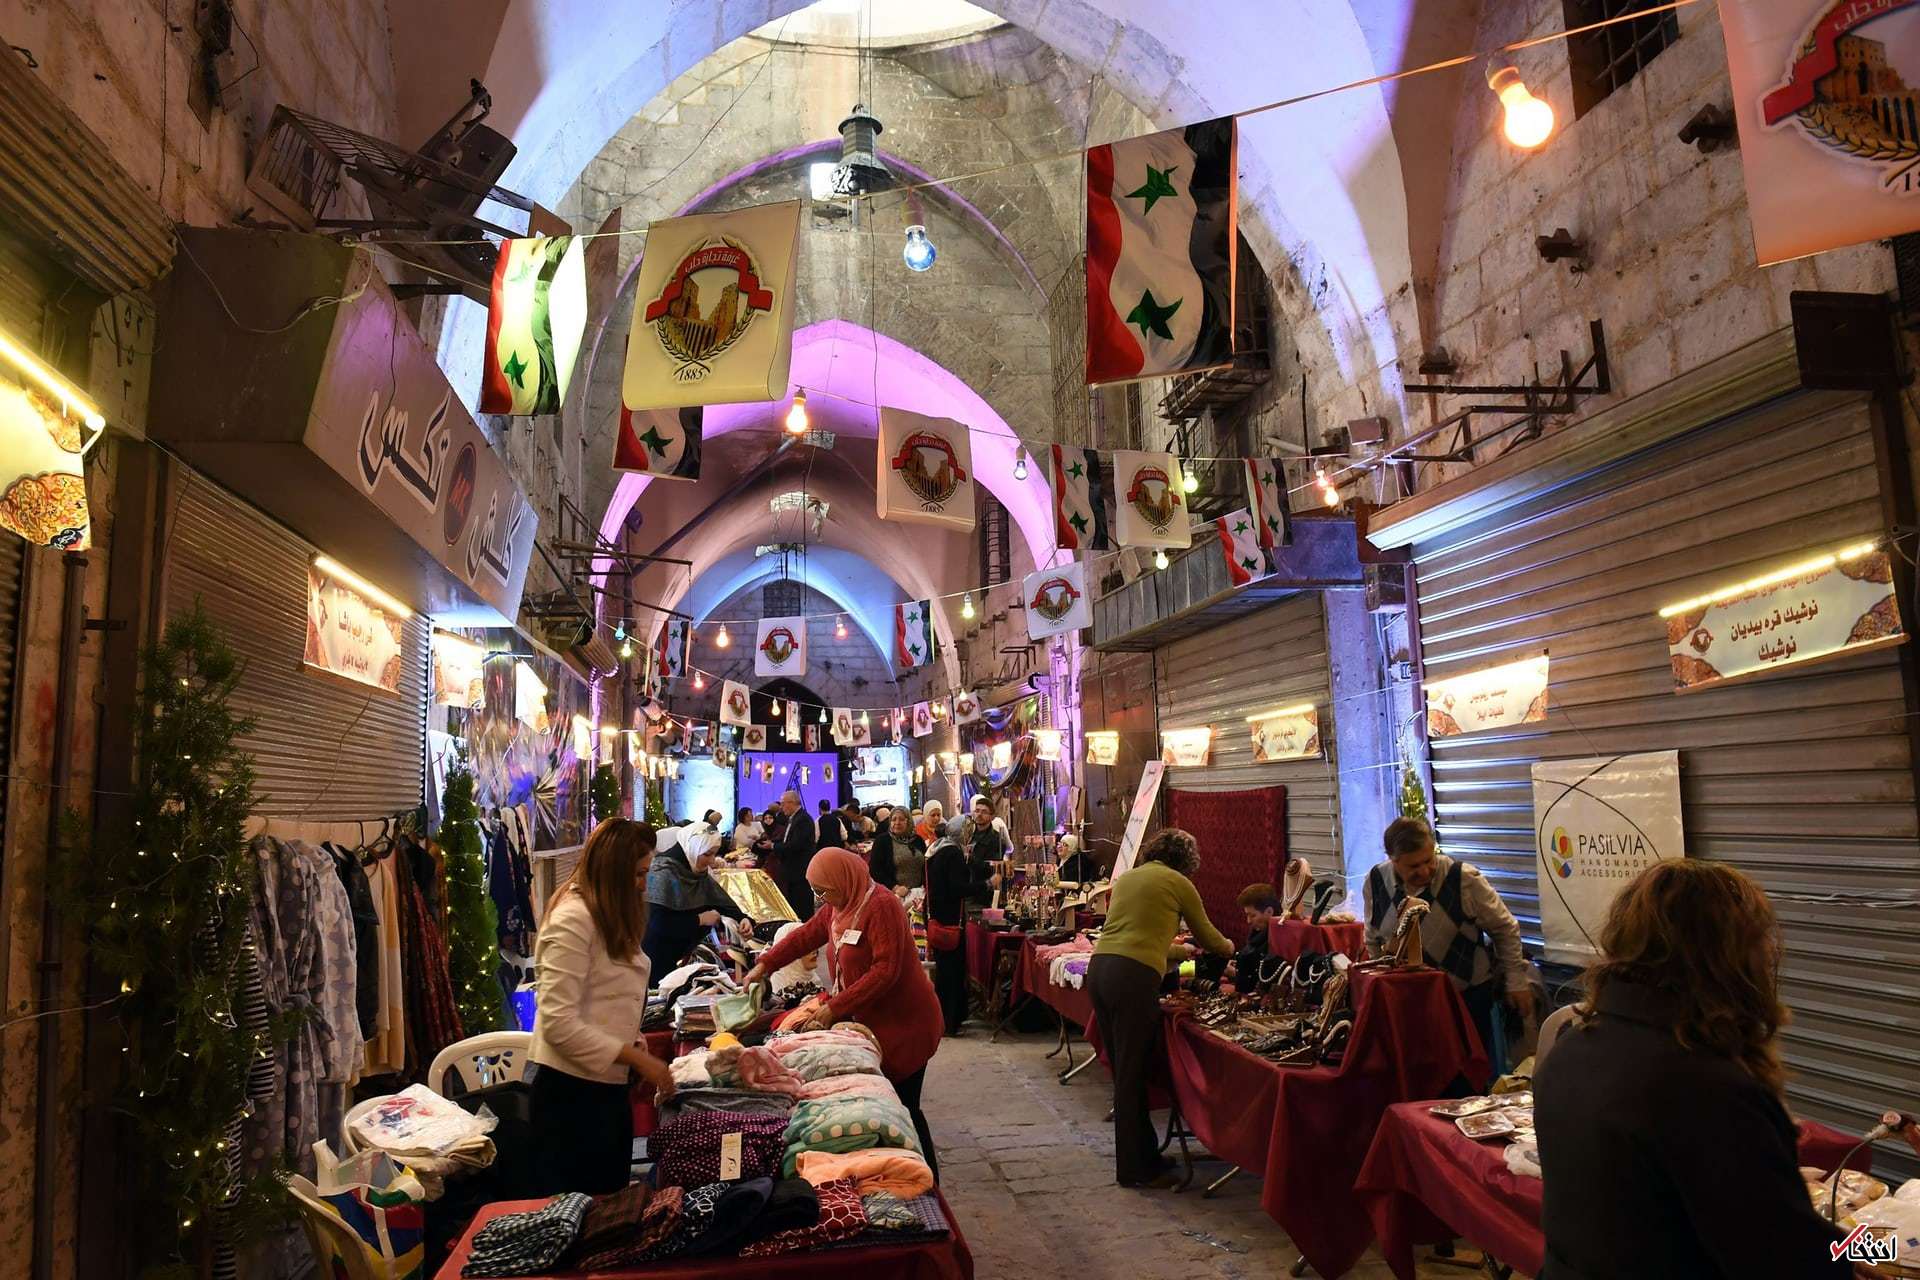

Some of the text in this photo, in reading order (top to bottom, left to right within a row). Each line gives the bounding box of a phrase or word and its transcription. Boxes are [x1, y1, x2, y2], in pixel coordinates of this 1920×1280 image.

[679, 367, 705, 381] 1885
[1731, 600, 1819, 642] نوشيك قره بيديان
[1758, 635, 1797, 662] نوشيك
[1580, 858, 1649, 869] HANDMADE
